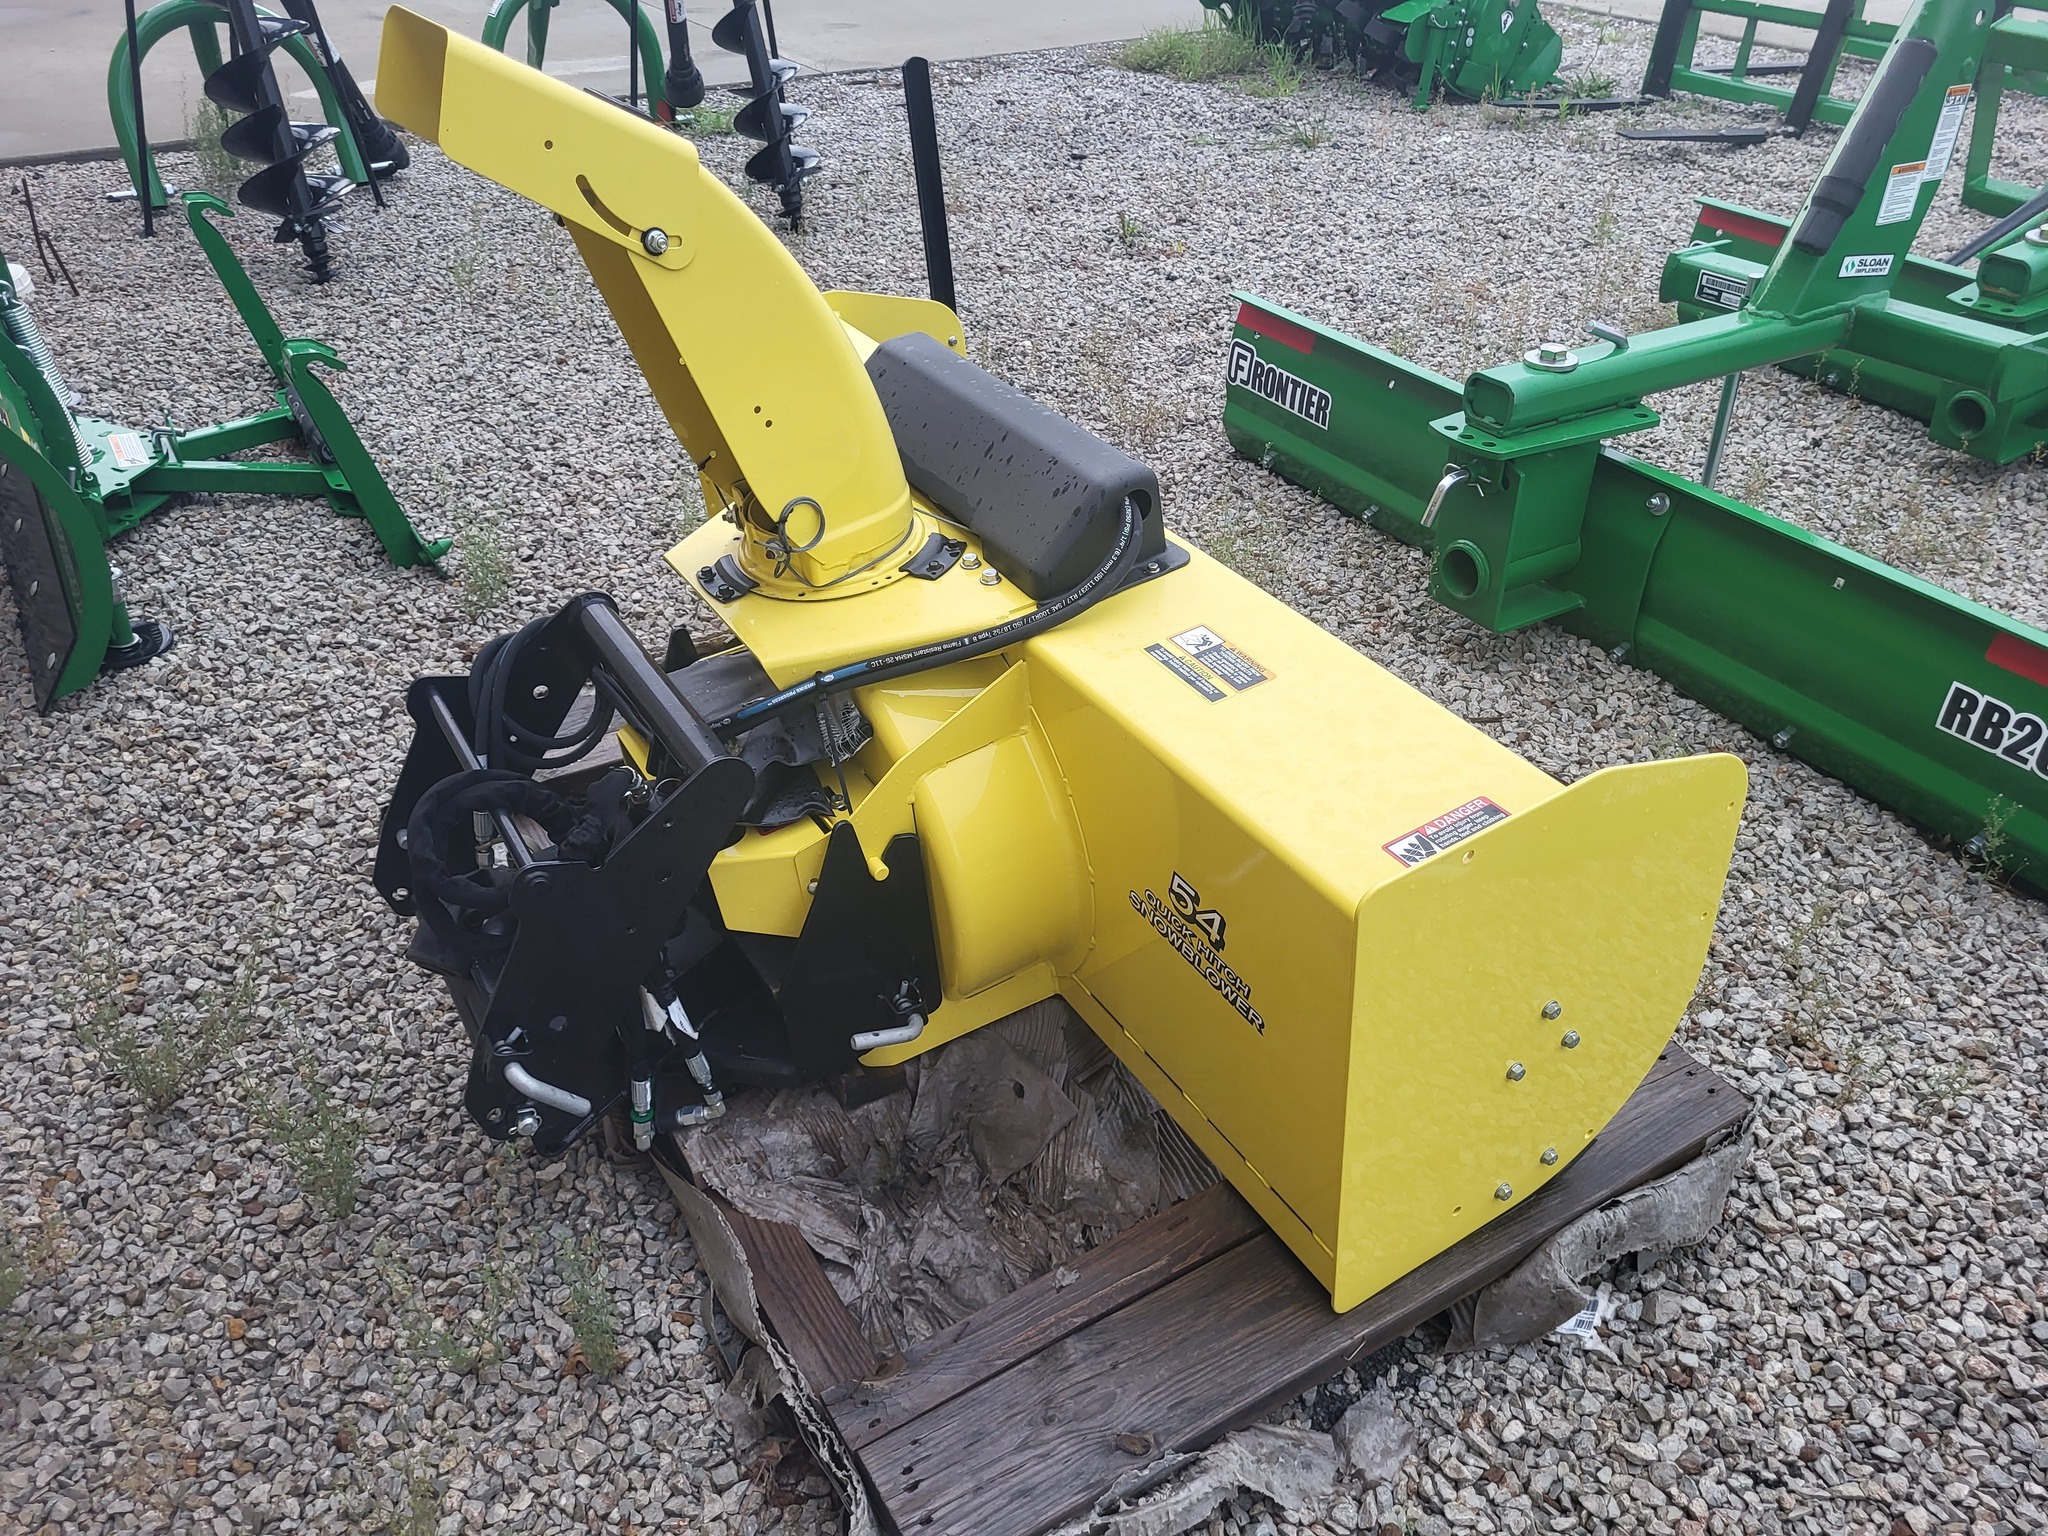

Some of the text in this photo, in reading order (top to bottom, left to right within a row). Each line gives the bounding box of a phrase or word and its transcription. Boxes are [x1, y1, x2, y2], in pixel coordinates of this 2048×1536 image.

[1857, 258, 1890, 267] SLOAN
[1228, 340, 1330, 428] FRONTIER
[1094, 572, 1104, 582] ISO
[1078, 580, 1096, 596] 11237
[1050, 602, 1062, 612] SAE
[1066, 593, 1078, 604] R17
[1012, 620, 1023, 629] ISO
[943, 640, 962, 649] Flame
[978, 631, 992, 640] Type
[894, 653, 913, 662] MSHA
[913, 645, 942, 656] Resistant
[1184, 658, 1214, 680] CAUTION
[1236, 650, 1267, 672] WARNING
[1434, 799, 1488, 829] DANGER
[1438, 826, 1454, 836] avoid
[1453, 817, 1470, 829] injury
[1469, 811, 1484, 820] from
[1435, 830, 1458, 844] rotating
[1474, 814, 1490, 824] keep
[1439, 812, 1507, 848] hands, feet and clothing
[1168, 871, 1226, 953] 54
[1144, 889, 1251, 1000] QUICK HITCH
[1129, 889, 1265, 1036] SNOWBLOWER
